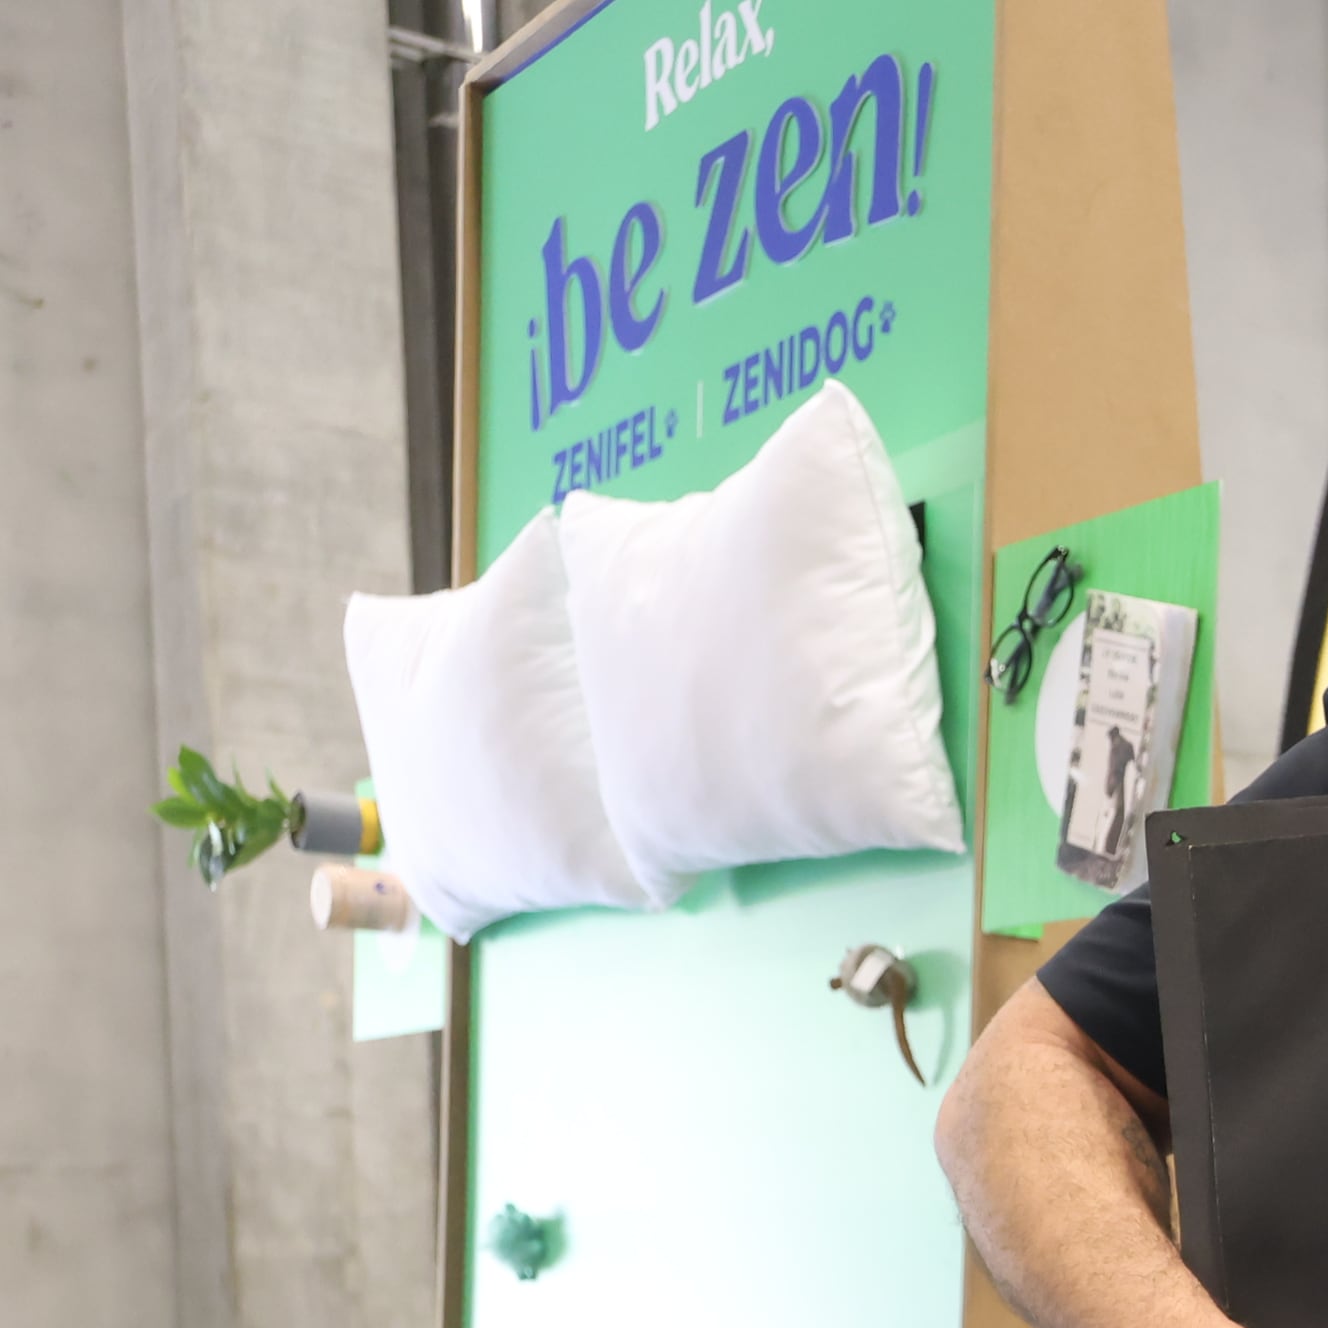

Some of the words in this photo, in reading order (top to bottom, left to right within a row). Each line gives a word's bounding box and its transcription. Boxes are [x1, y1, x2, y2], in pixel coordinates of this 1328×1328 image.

[643, 0, 775, 132] Relax,
[527, 202, 667, 432] ¡be
[692, 53, 934, 306] zen!
[552, 405, 663, 505] ZENIFEL
[722, 295, 875, 427] ZENIDOG
